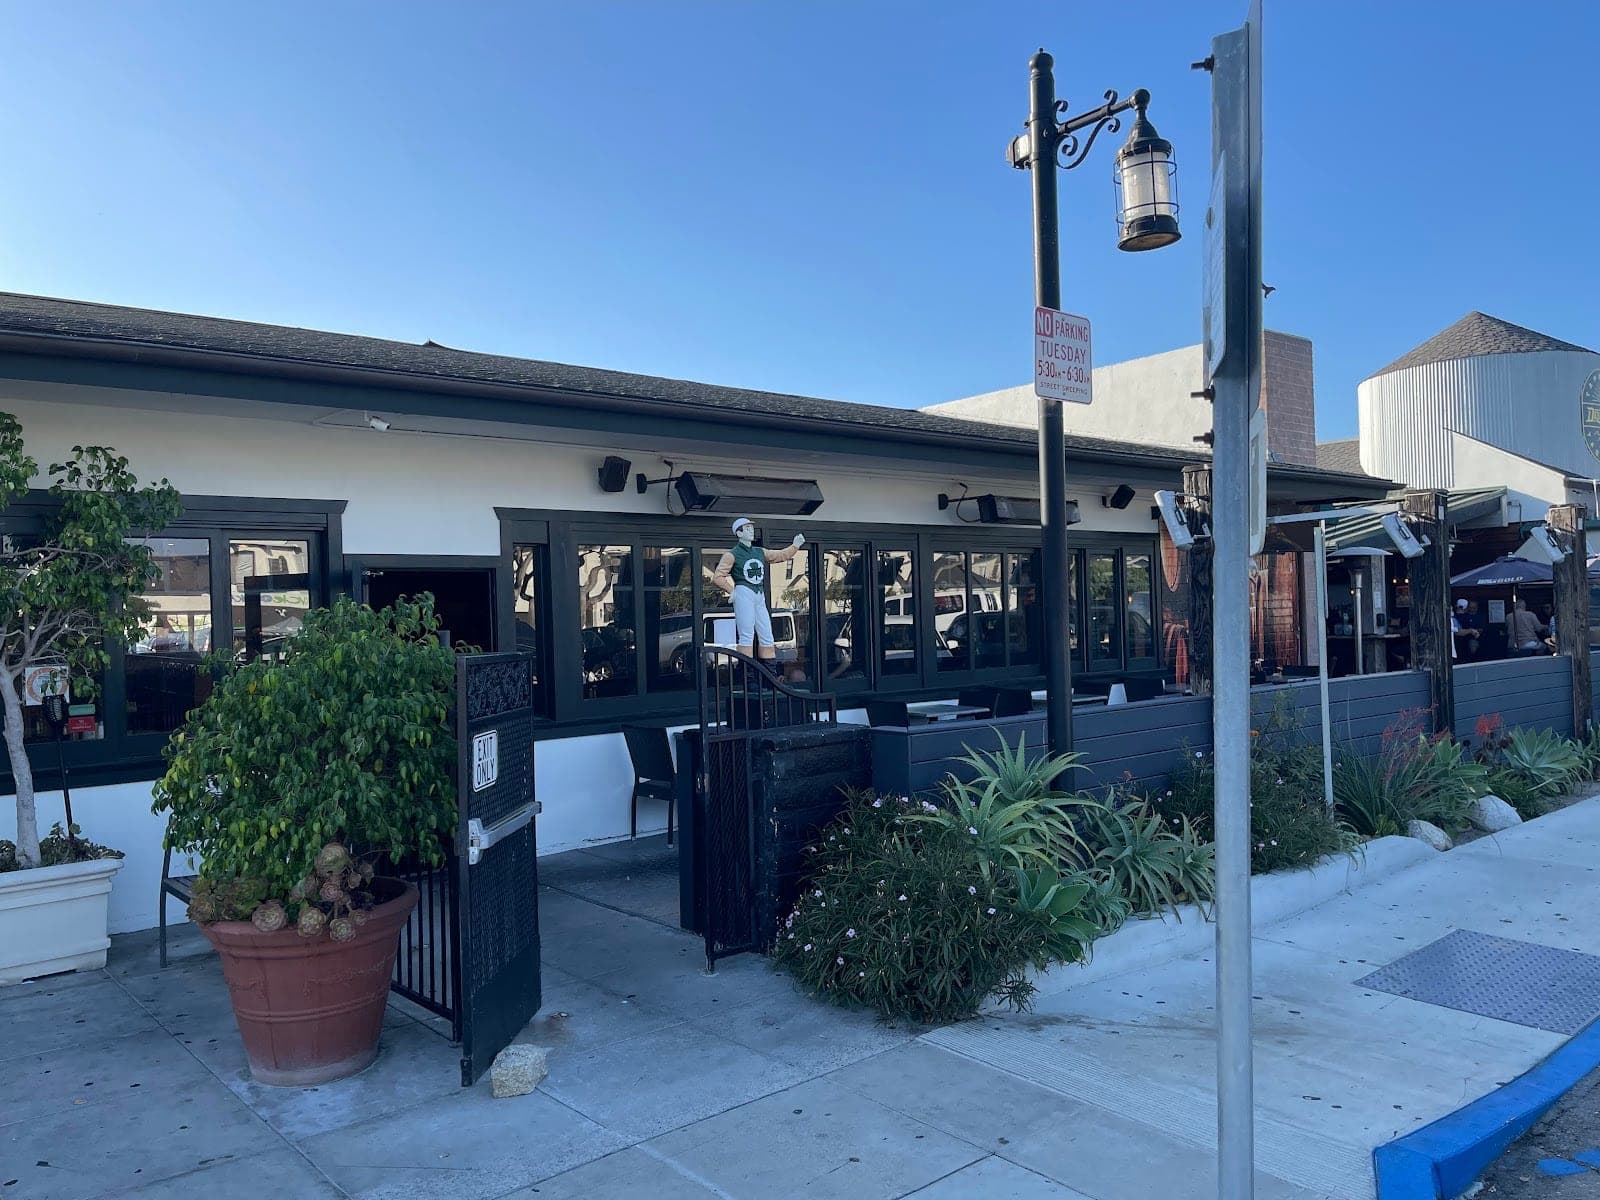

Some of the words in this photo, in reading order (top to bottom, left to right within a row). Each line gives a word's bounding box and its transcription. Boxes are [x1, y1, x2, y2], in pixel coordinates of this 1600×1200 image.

[1036, 311, 1052, 336] NO
[1056, 319, 1088, 342] PARKING
[1040, 340, 1086, 364] TUESDAY
[1040, 381, 1061, 391] STREET
[478, 736, 494, 761] EXIT
[477, 758, 495, 785] ONLY
